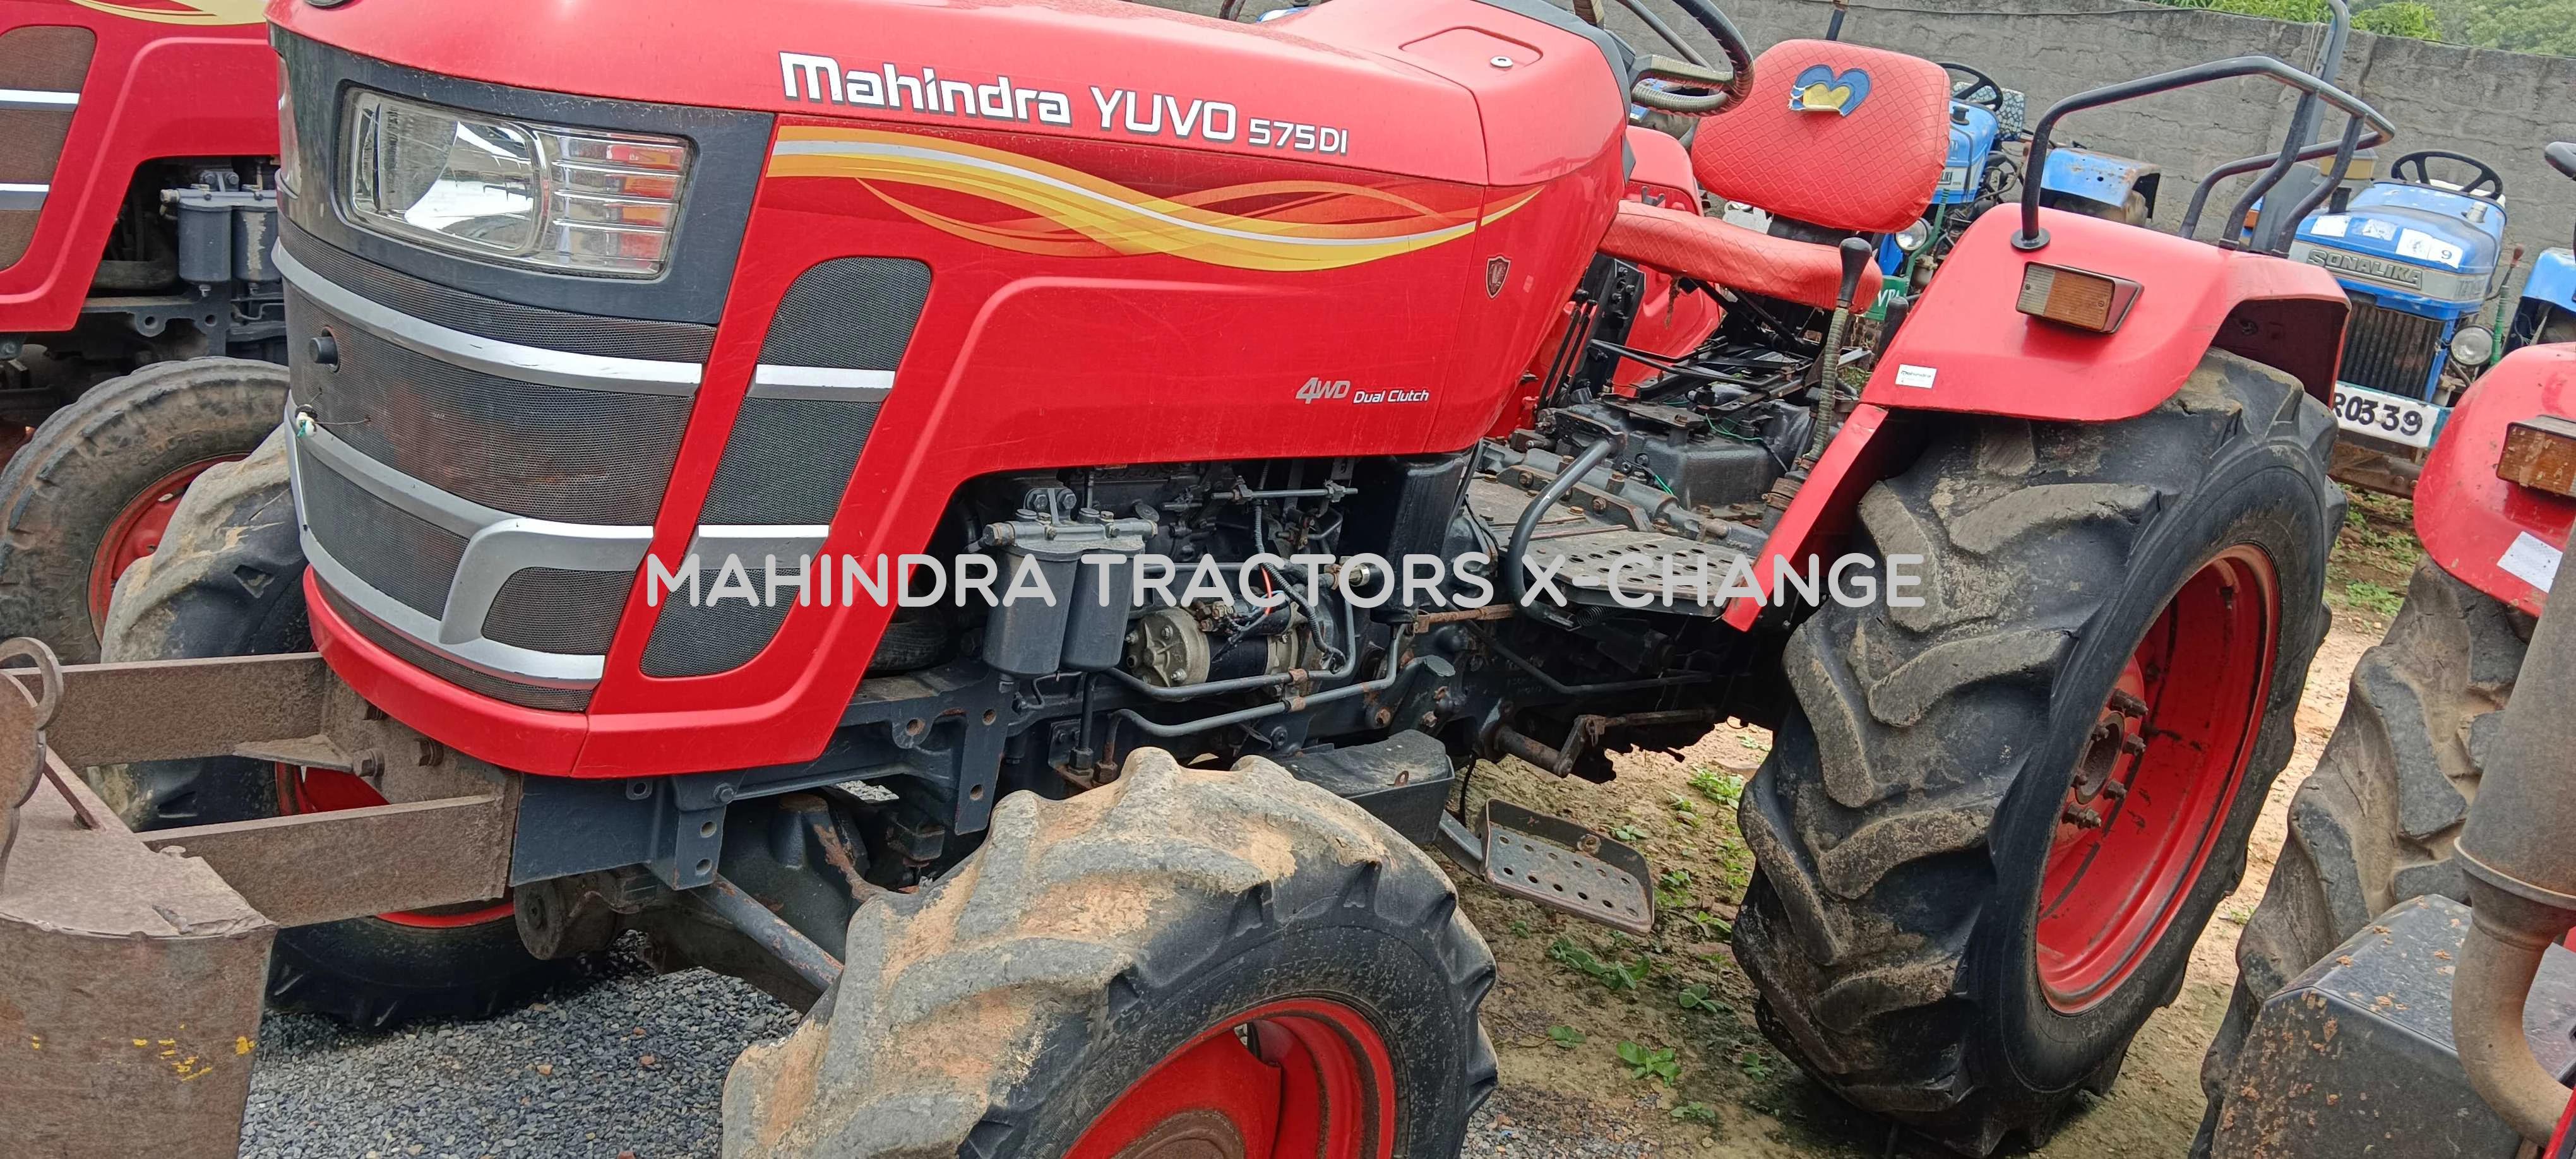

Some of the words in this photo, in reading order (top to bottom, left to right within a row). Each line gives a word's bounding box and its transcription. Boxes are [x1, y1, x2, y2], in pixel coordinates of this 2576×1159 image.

[778, 51, 1071, 124] Mahindra
[1090, 86, 1237, 142] YUVO
[1249, 120, 1348, 155] 575DI
[2306, 249, 2423, 285] SONALIKA
[1296, 377, 1351, 405] 4WD
[1353, 390, 1385, 404] Dual
[1387, 389, 1429, 402] Clutch
